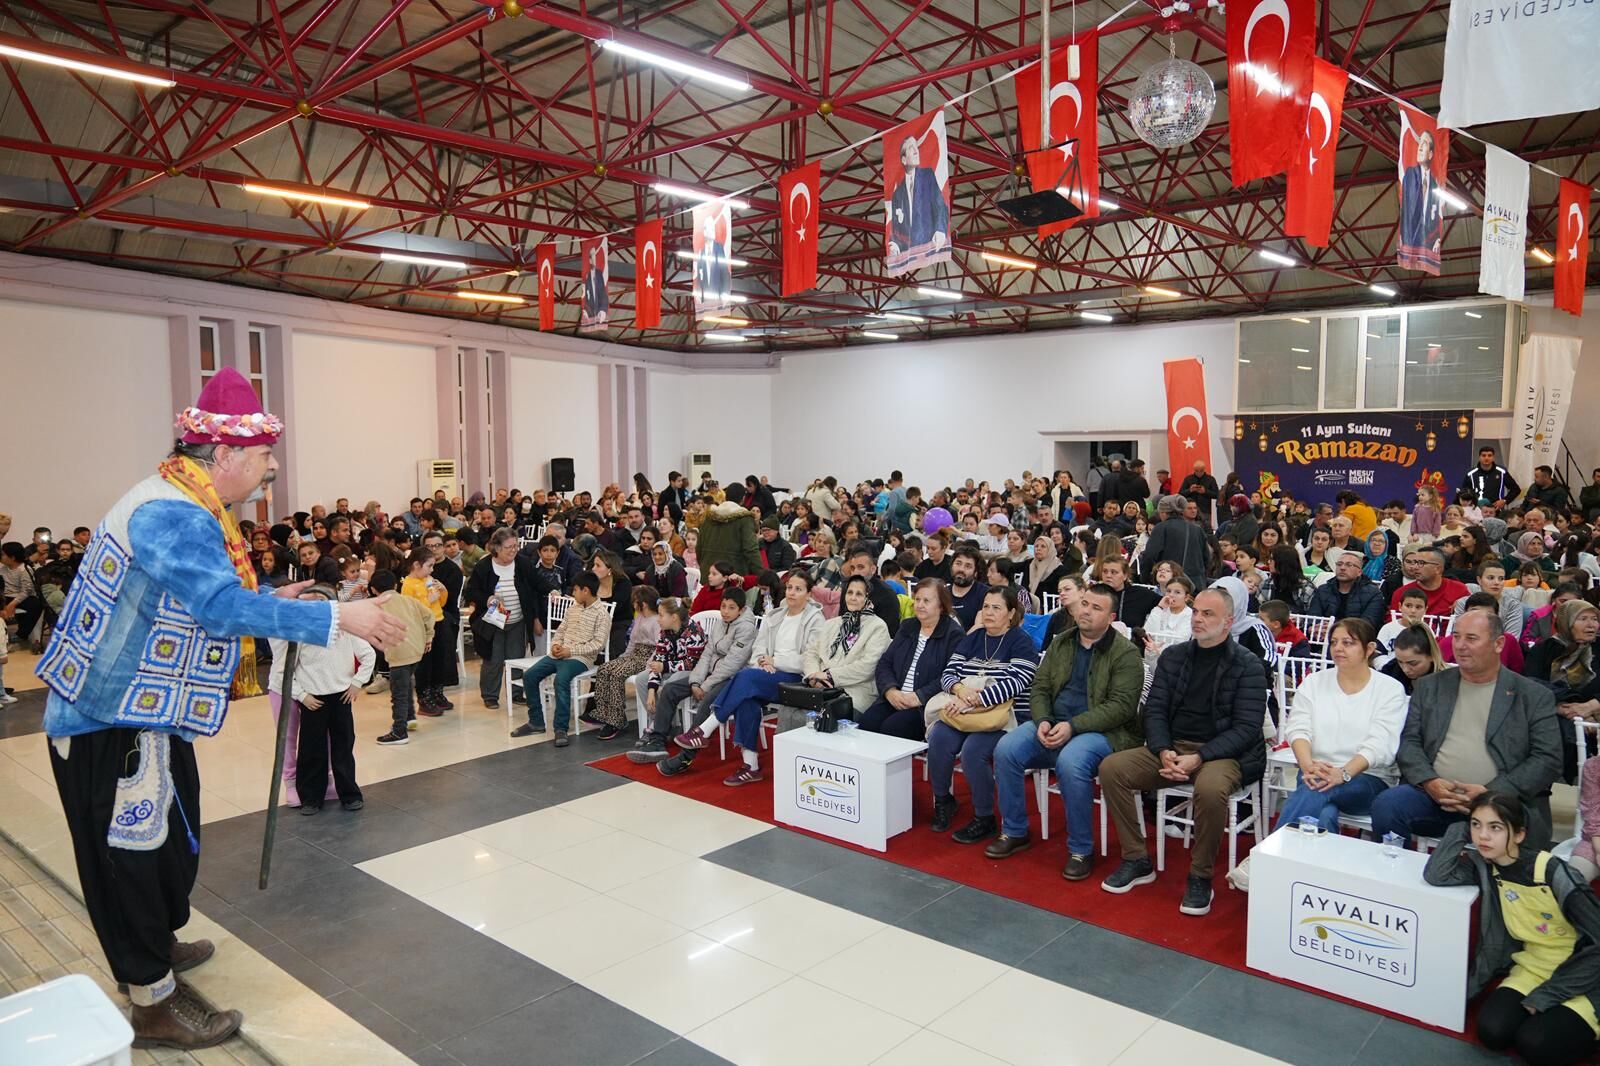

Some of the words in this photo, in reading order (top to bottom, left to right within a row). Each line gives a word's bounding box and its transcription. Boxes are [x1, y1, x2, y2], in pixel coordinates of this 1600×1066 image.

[1301, 426, 1312, 438] 11
[1316, 425, 1343, 438] Ayın
[1347, 423, 1392, 438] Sultanı
[1275, 440, 1418, 467] Ramazan
[1349, 469, 1374, 477] MESUT
[800, 764, 856, 786] AYVALIK
[800, 794, 856, 816] BELEDİYESİ
[1301, 894, 1409, 933] AYVALIK
[1298, 935, 1407, 976] BELEDİYESİ
